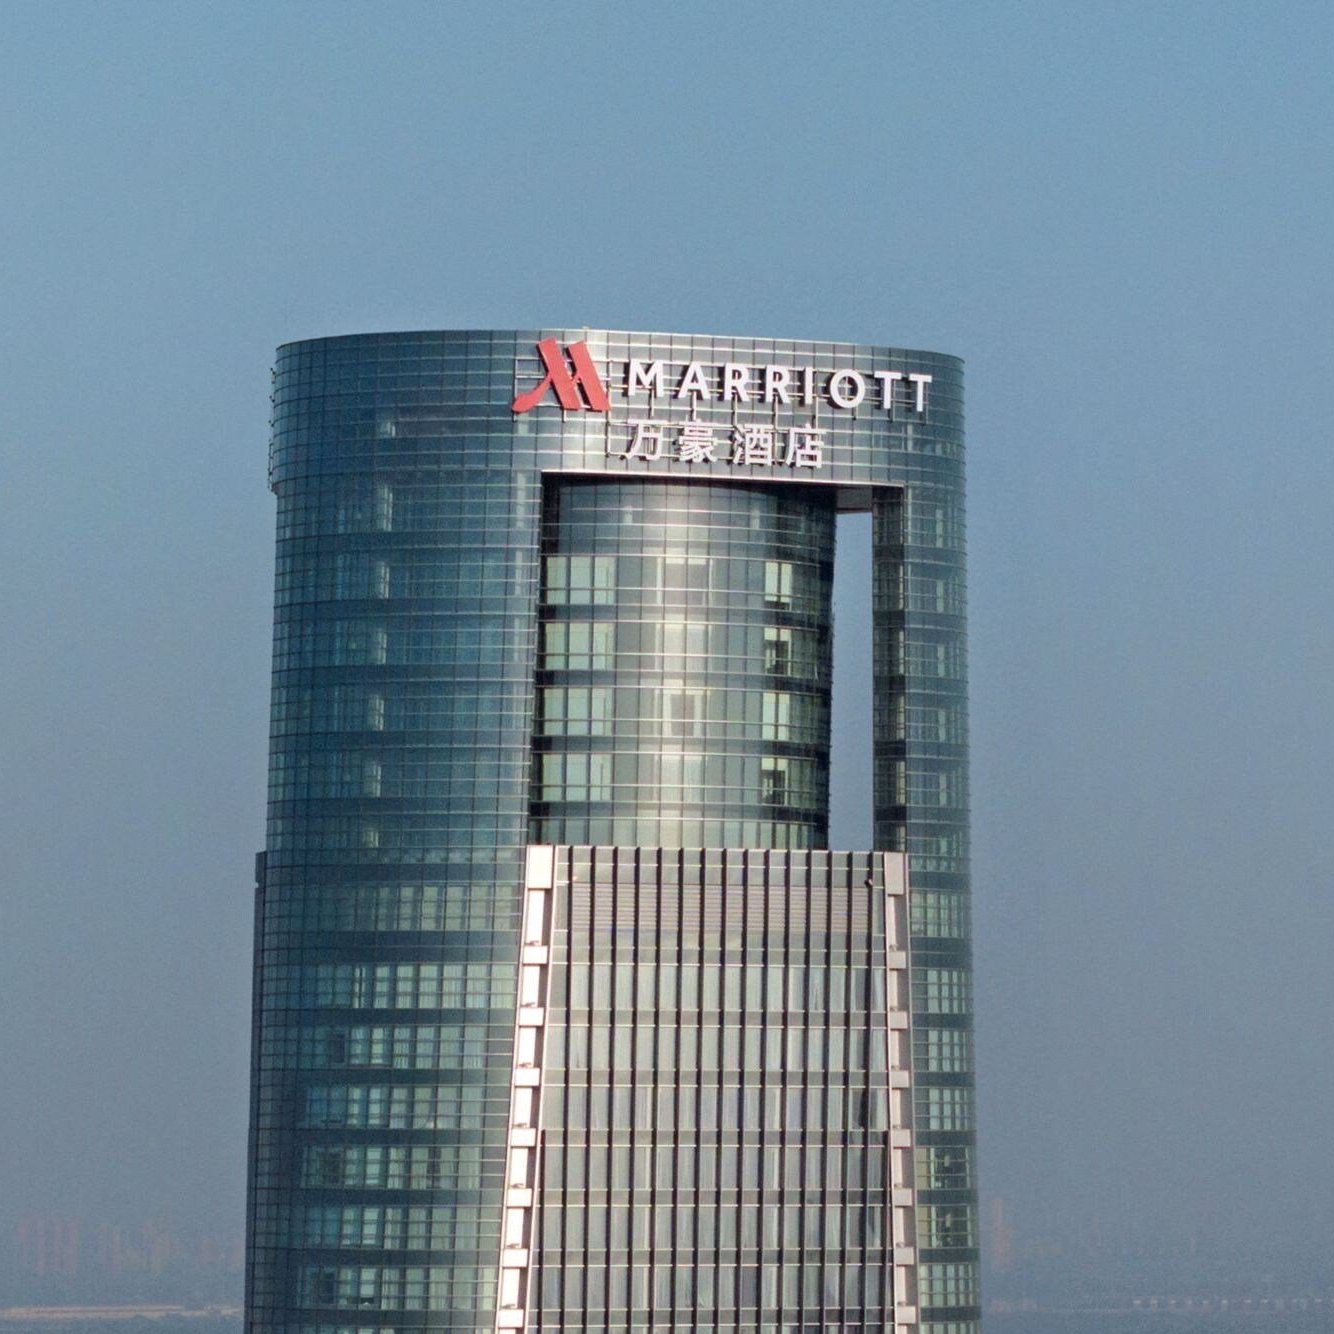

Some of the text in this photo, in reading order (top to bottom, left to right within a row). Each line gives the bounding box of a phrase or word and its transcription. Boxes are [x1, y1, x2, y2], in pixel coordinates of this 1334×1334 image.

[627, 358, 933, 412] MARRIOTT
[625, 418, 827, 468] 万豪酒店
